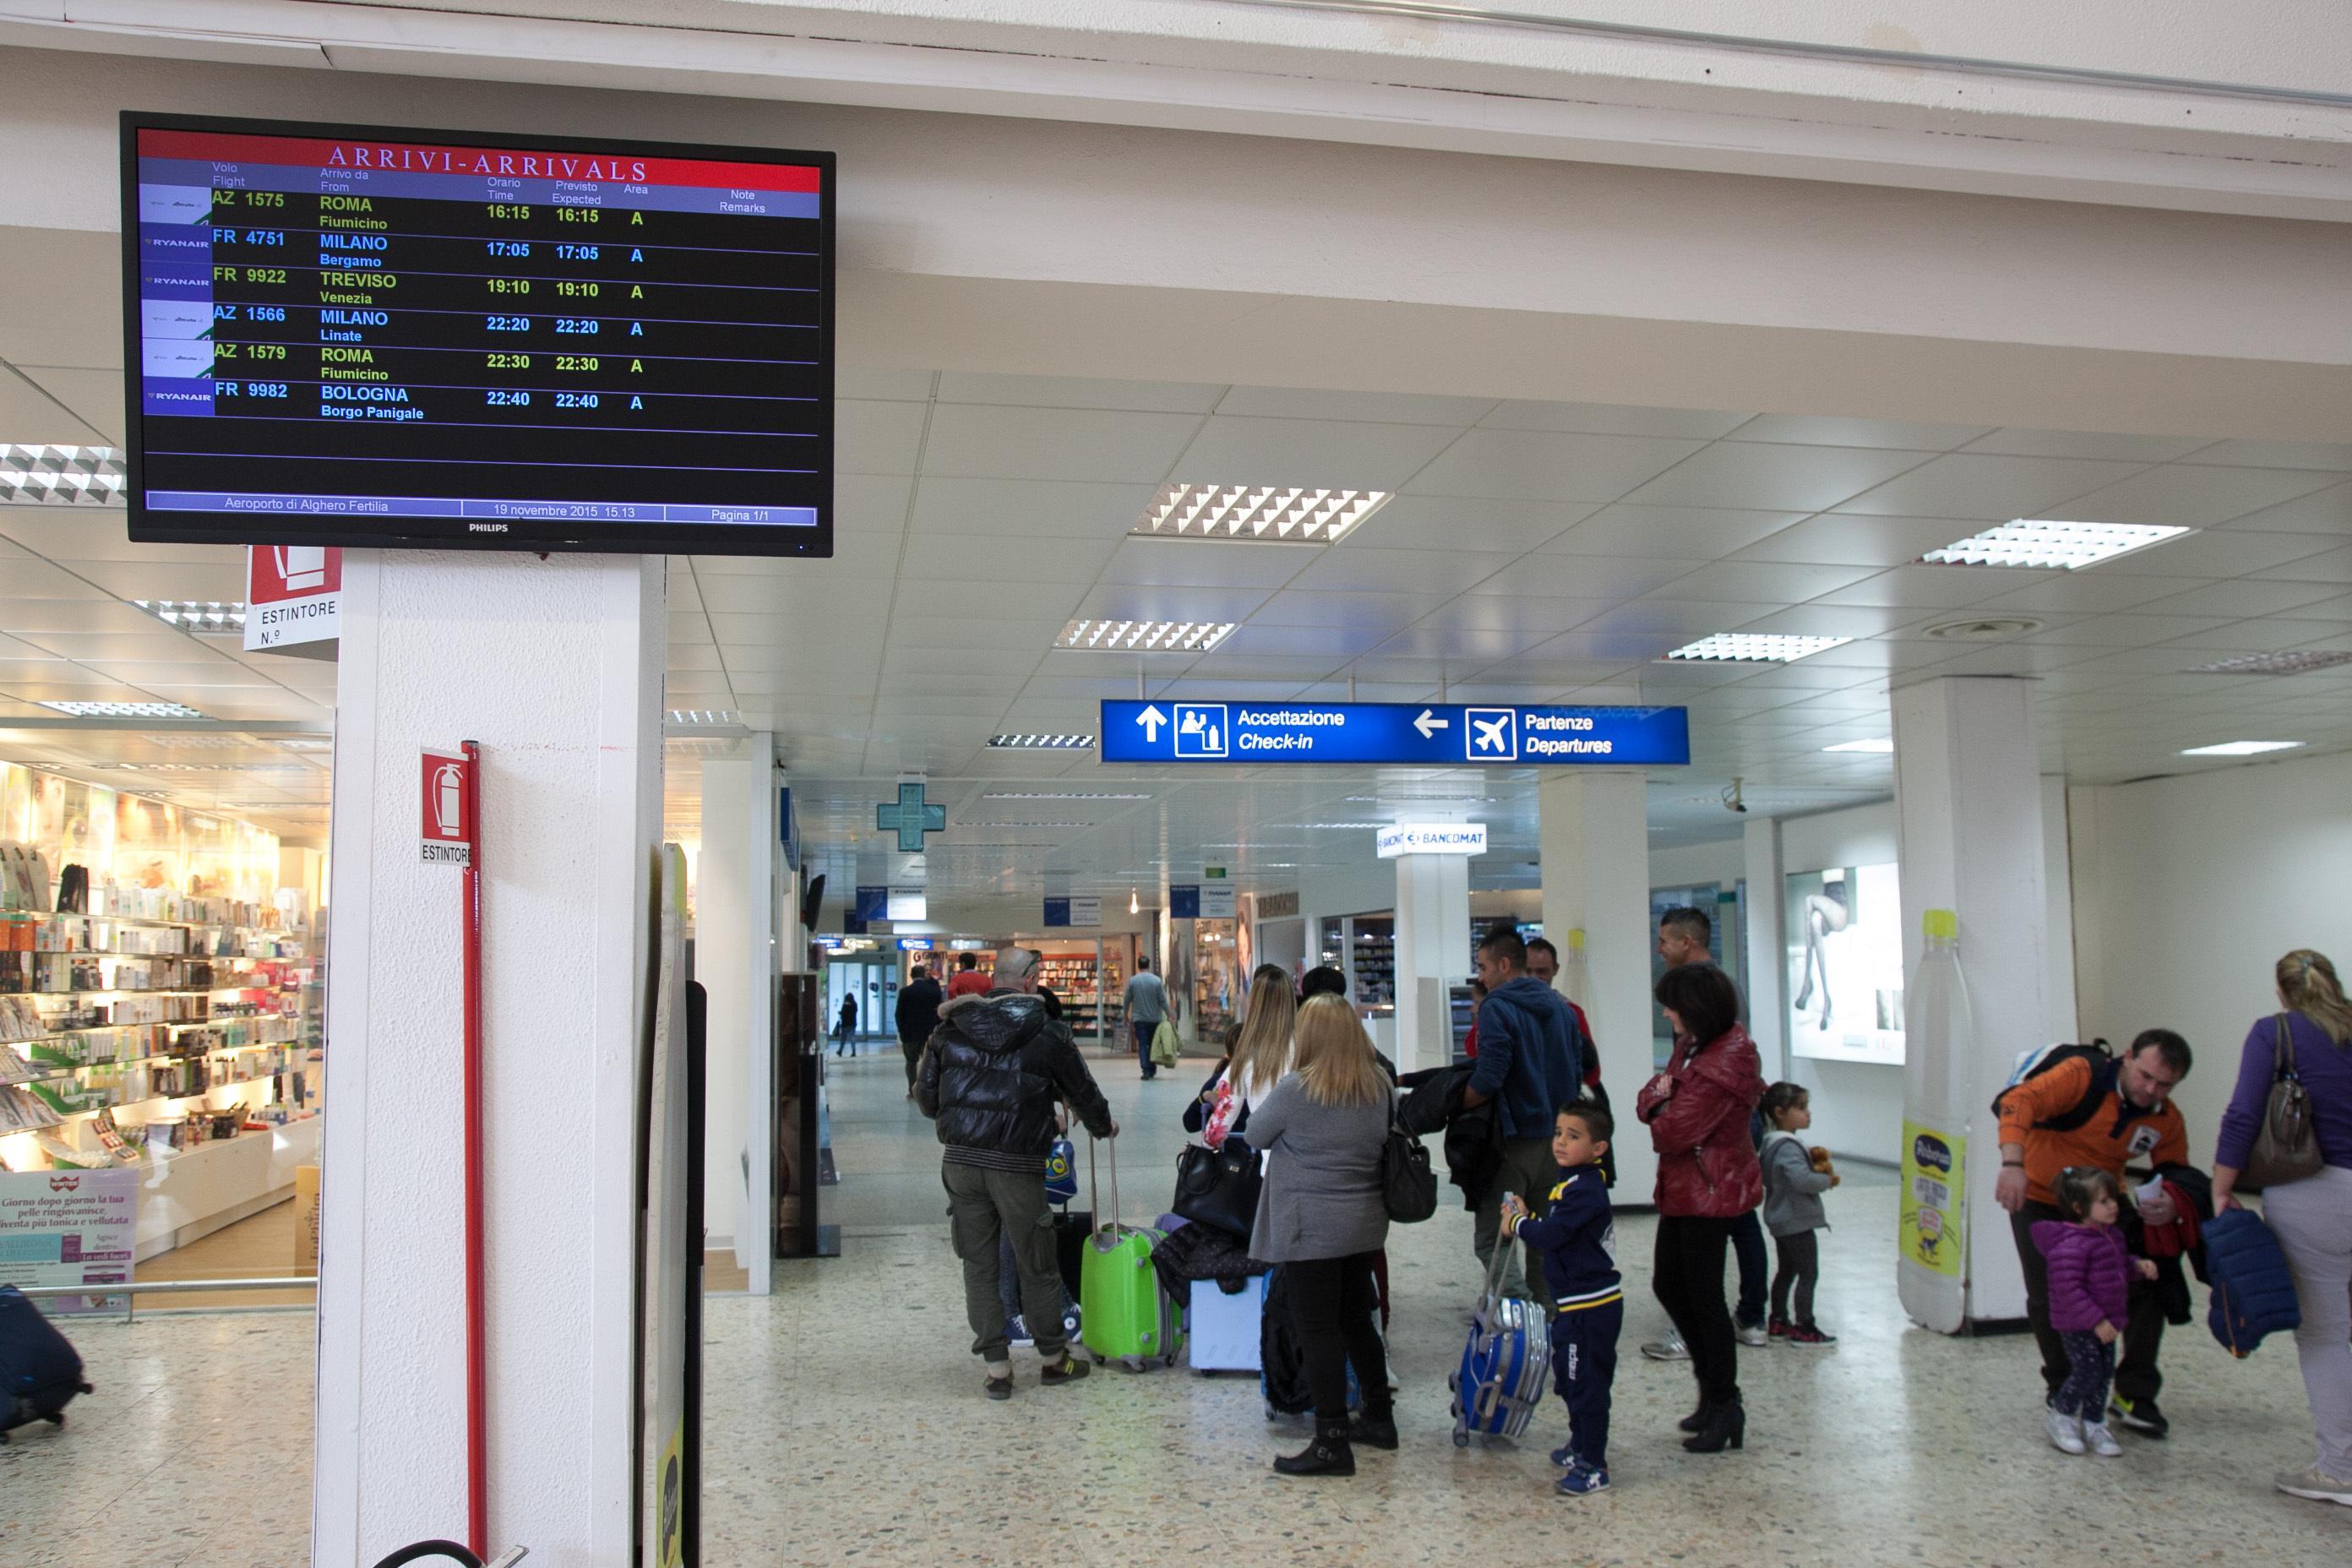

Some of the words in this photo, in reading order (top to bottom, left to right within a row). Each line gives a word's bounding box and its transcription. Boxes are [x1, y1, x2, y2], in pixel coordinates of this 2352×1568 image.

[212, 161, 237, 173] Volo
[327, 146, 646, 182] ARRIVI-ARRIVALS
[213, 175, 245, 188] Flight
[320, 168, 351, 180] Arrivo
[355, 170, 369, 181] da
[321, 181, 349, 192] From
[487, 177, 520, 188] Orario
[556, 181, 598, 192] Previsto
[623, 184, 648, 195] Area
[212, 191, 235, 205] AZ
[245, 193, 284, 207] 1575
[487, 190, 514, 201] Time
[552, 193, 602, 205] Expected
[731, 189, 755, 200] Note
[320, 197, 373, 212] ROMA
[487, 204, 530, 220] 16:15
[720, 202, 765, 214] Remarks
[320, 216, 388, 230] Fiumicino
[556, 208, 599, 223] 16:15
[631, 212, 643, 226] A
[153, 239, 210, 248] RYANAIR
[213, 229, 236, 243] FR
[246, 231, 284, 246] 4751
[320, 234, 388, 251] MILANO
[487, 242, 530, 257] 17:05
[556, 245, 599, 261] 17:05
[631, 248, 643, 263] A
[320, 254, 382, 269] Bergamo
[154, 276, 210, 286] RYANAIR
[214, 267, 237, 281] FR
[247, 269, 286, 284] 9922
[320, 272, 396, 288] TREVISO
[487, 280, 530, 294] 19:10
[557, 282, 599, 297] 19:10
[631, 286, 643, 299] A
[320, 291, 372, 305] Venezia
[213, 305, 237, 320] AZ
[246, 307, 286, 322] 1566
[320, 309, 388, 326] MILANO
[487, 317, 530, 332] 22:20
[556, 319, 599, 335] 22:20
[630, 323, 643, 336] A
[320, 329, 362, 342] Linate
[214, 344, 237, 358] AZ
[247, 345, 286, 360] 1579
[321, 347, 373, 363] ROMA
[487, 354, 530, 369] 22:30
[556, 357, 598, 372] 22:30
[630, 359, 643, 373] A
[321, 367, 389, 381] Fiumicino
[156, 392, 211, 401] RYANAIR
[215, 382, 238, 397] FR
[248, 383, 287, 398] 9982
[322, 385, 409, 402] BOLOGNA
[487, 391, 530, 406] 22:40
[556, 394, 598, 409] 22:40
[630, 396, 643, 410] A
[321, 405, 363, 419] Borgo
[367, 406, 424, 421] Panigale
[225, 498, 283, 512] Aeroporto
[286, 498, 297, 509] di
[299, 498, 346, 513] Alghero
[350, 500, 389, 512] Fertilia
[494, 504, 507, 515] 19
[510, 504, 567, 517] novembre
[570, 506, 598, 518] 2015
[711, 509, 750, 522] Pagina
[754, 510, 769, 521] 1/1
[470, 524, 508, 532] PHILIPS
[262, 601, 335, 624] ESTINTORE
[1238, 710, 1345, 726] Accettazione
[1525, 714, 1593, 731] Partenze
[1239, 732, 1313, 749] Check-in
[1525, 737, 1612, 756] Departures
[1423, 833, 1484, 843] BANCOMAT
[2, 1197, 35, 1207] Giorno
[38, 1197, 63, 1208] dopo
[64, 1195, 95, 1206] giorno
[98, 1195, 107, 1204] la
[109, 1195, 124, 1204] tua
[18, 1209, 41, 1219] pelle
[0, 1219, 30, 1229] iventa
[32, 1219, 47, 1229] più
[49, 1217, 79, 1227] tonica
[89, 1217, 128, 1226] vellutata
[96, 1234, 118, 1243] Agisce
